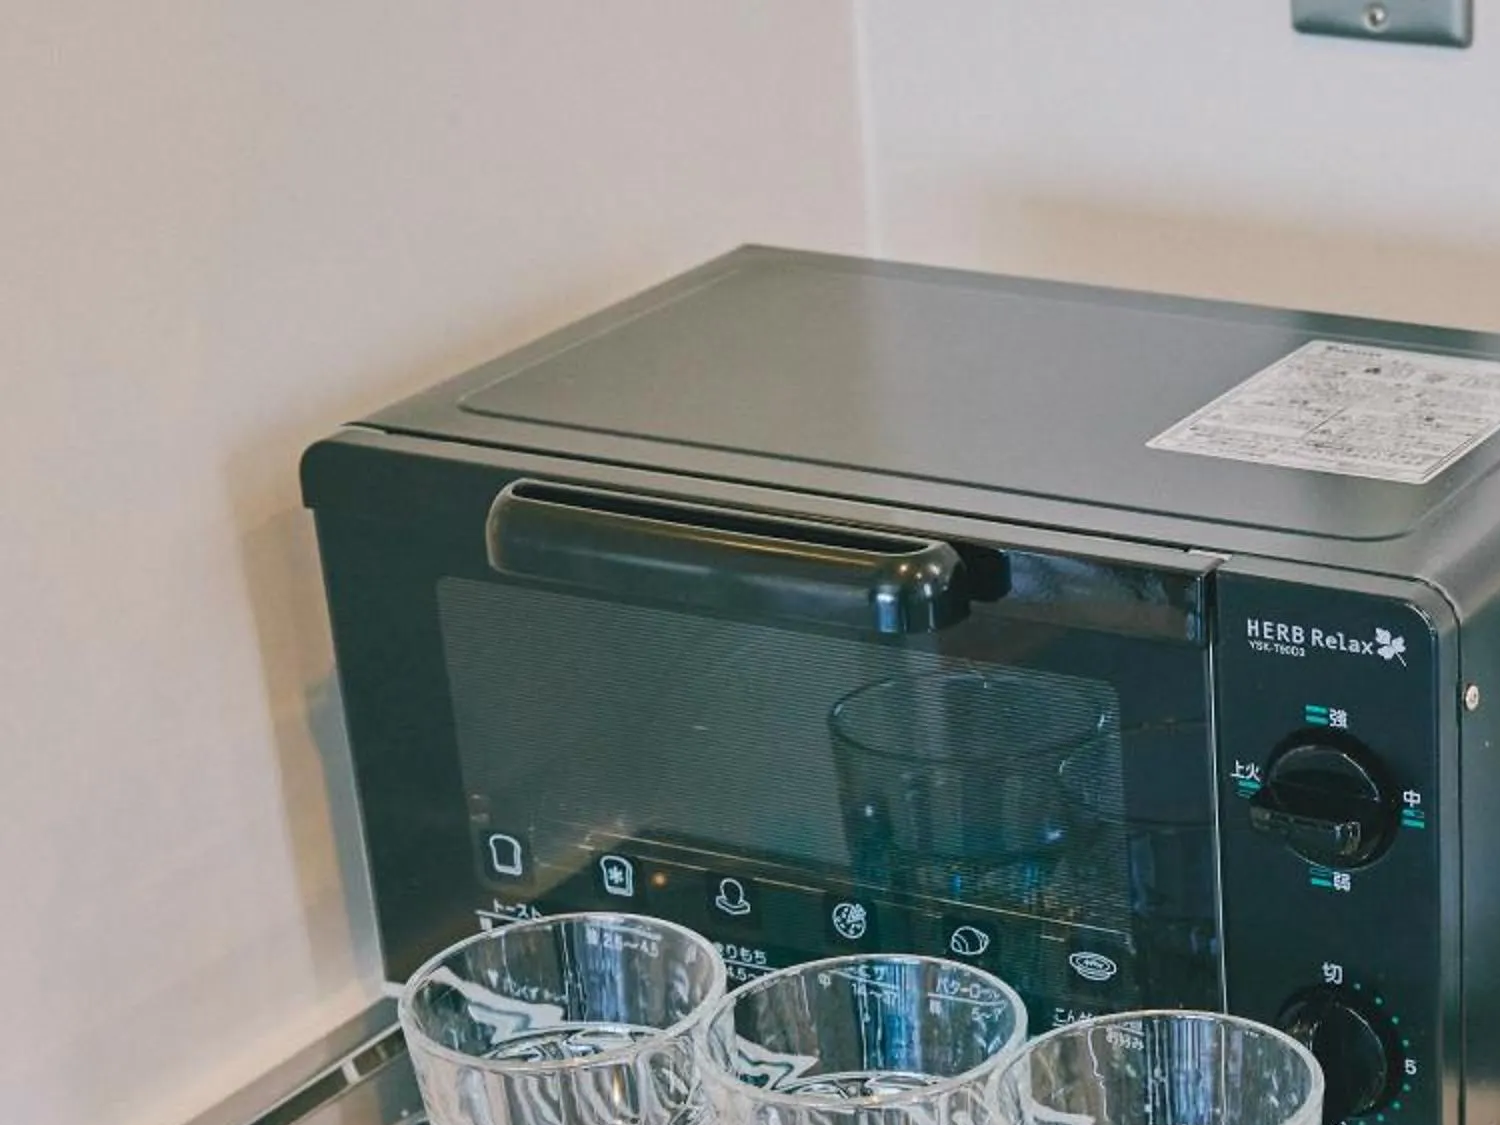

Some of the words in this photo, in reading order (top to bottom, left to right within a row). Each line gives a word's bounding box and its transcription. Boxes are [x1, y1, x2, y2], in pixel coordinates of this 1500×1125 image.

[1247, 618, 1305, 644] HERB
[1311, 627, 1374, 655] Relax
[1231, 759, 1261, 782] 上火
[1403, 789, 1421, 808] 中
[1321, 961, 1343, 985] 切
[1404, 1059, 1417, 1076] 5
